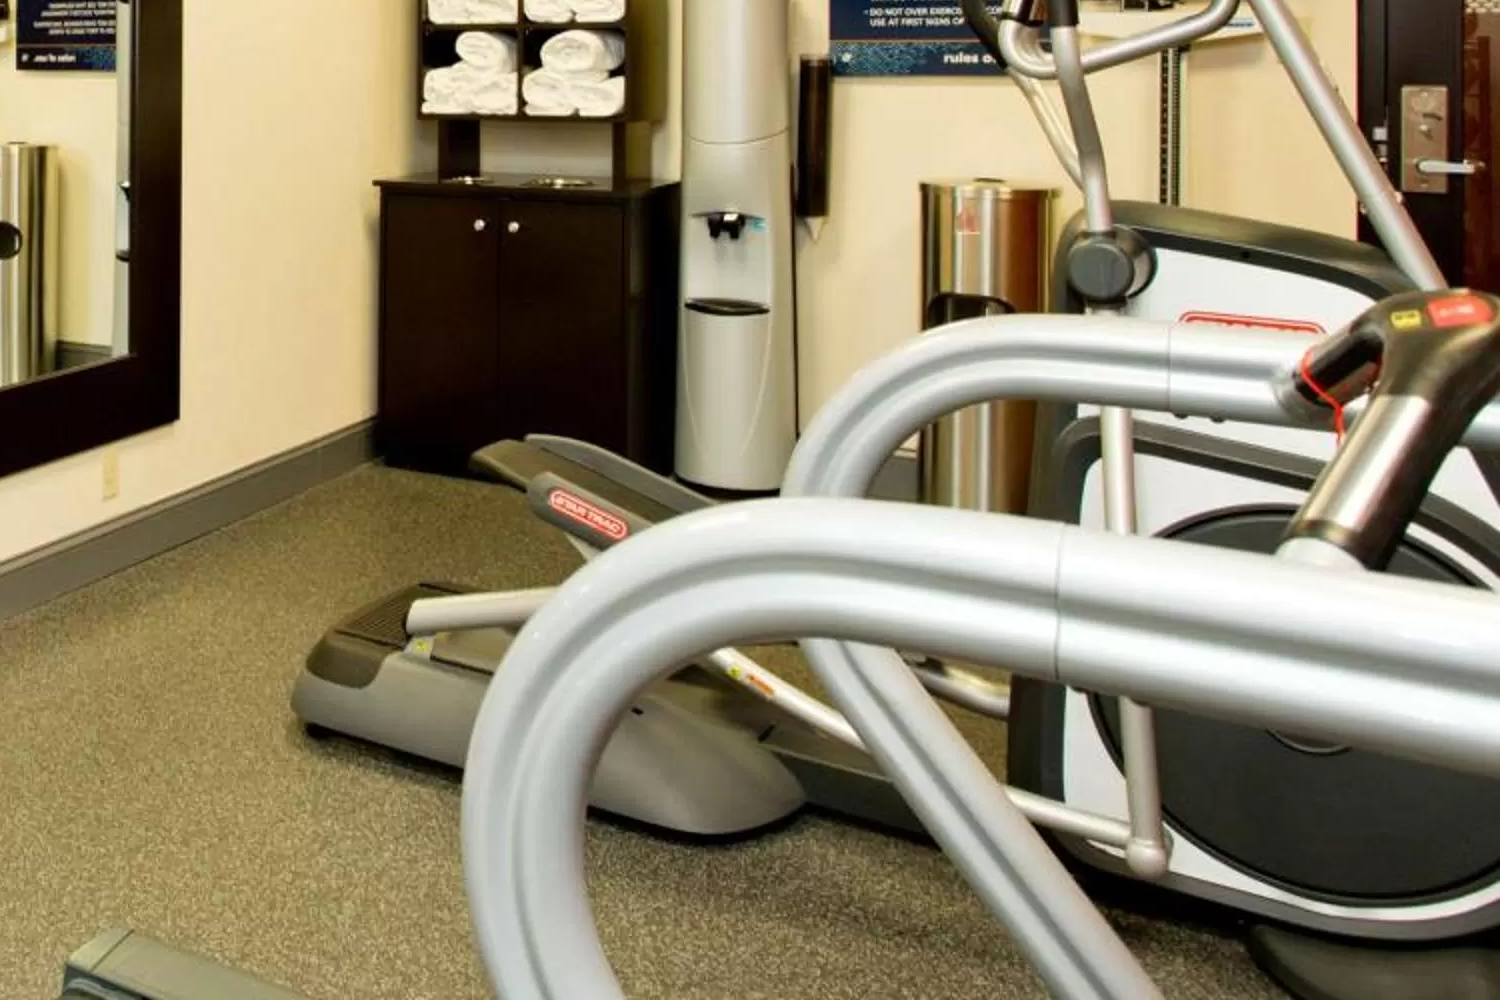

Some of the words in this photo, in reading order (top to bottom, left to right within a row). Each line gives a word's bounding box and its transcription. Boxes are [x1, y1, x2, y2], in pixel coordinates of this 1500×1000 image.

[870, 8, 883, 17] DO
[870, 18, 886, 27] USE
[887, 18, 899, 27] AT
[943, 52, 979, 64] rules
[982, 53, 996, 64] o
[555, 497, 587, 516] STAR
[586, 510, 622, 533] TRAC
